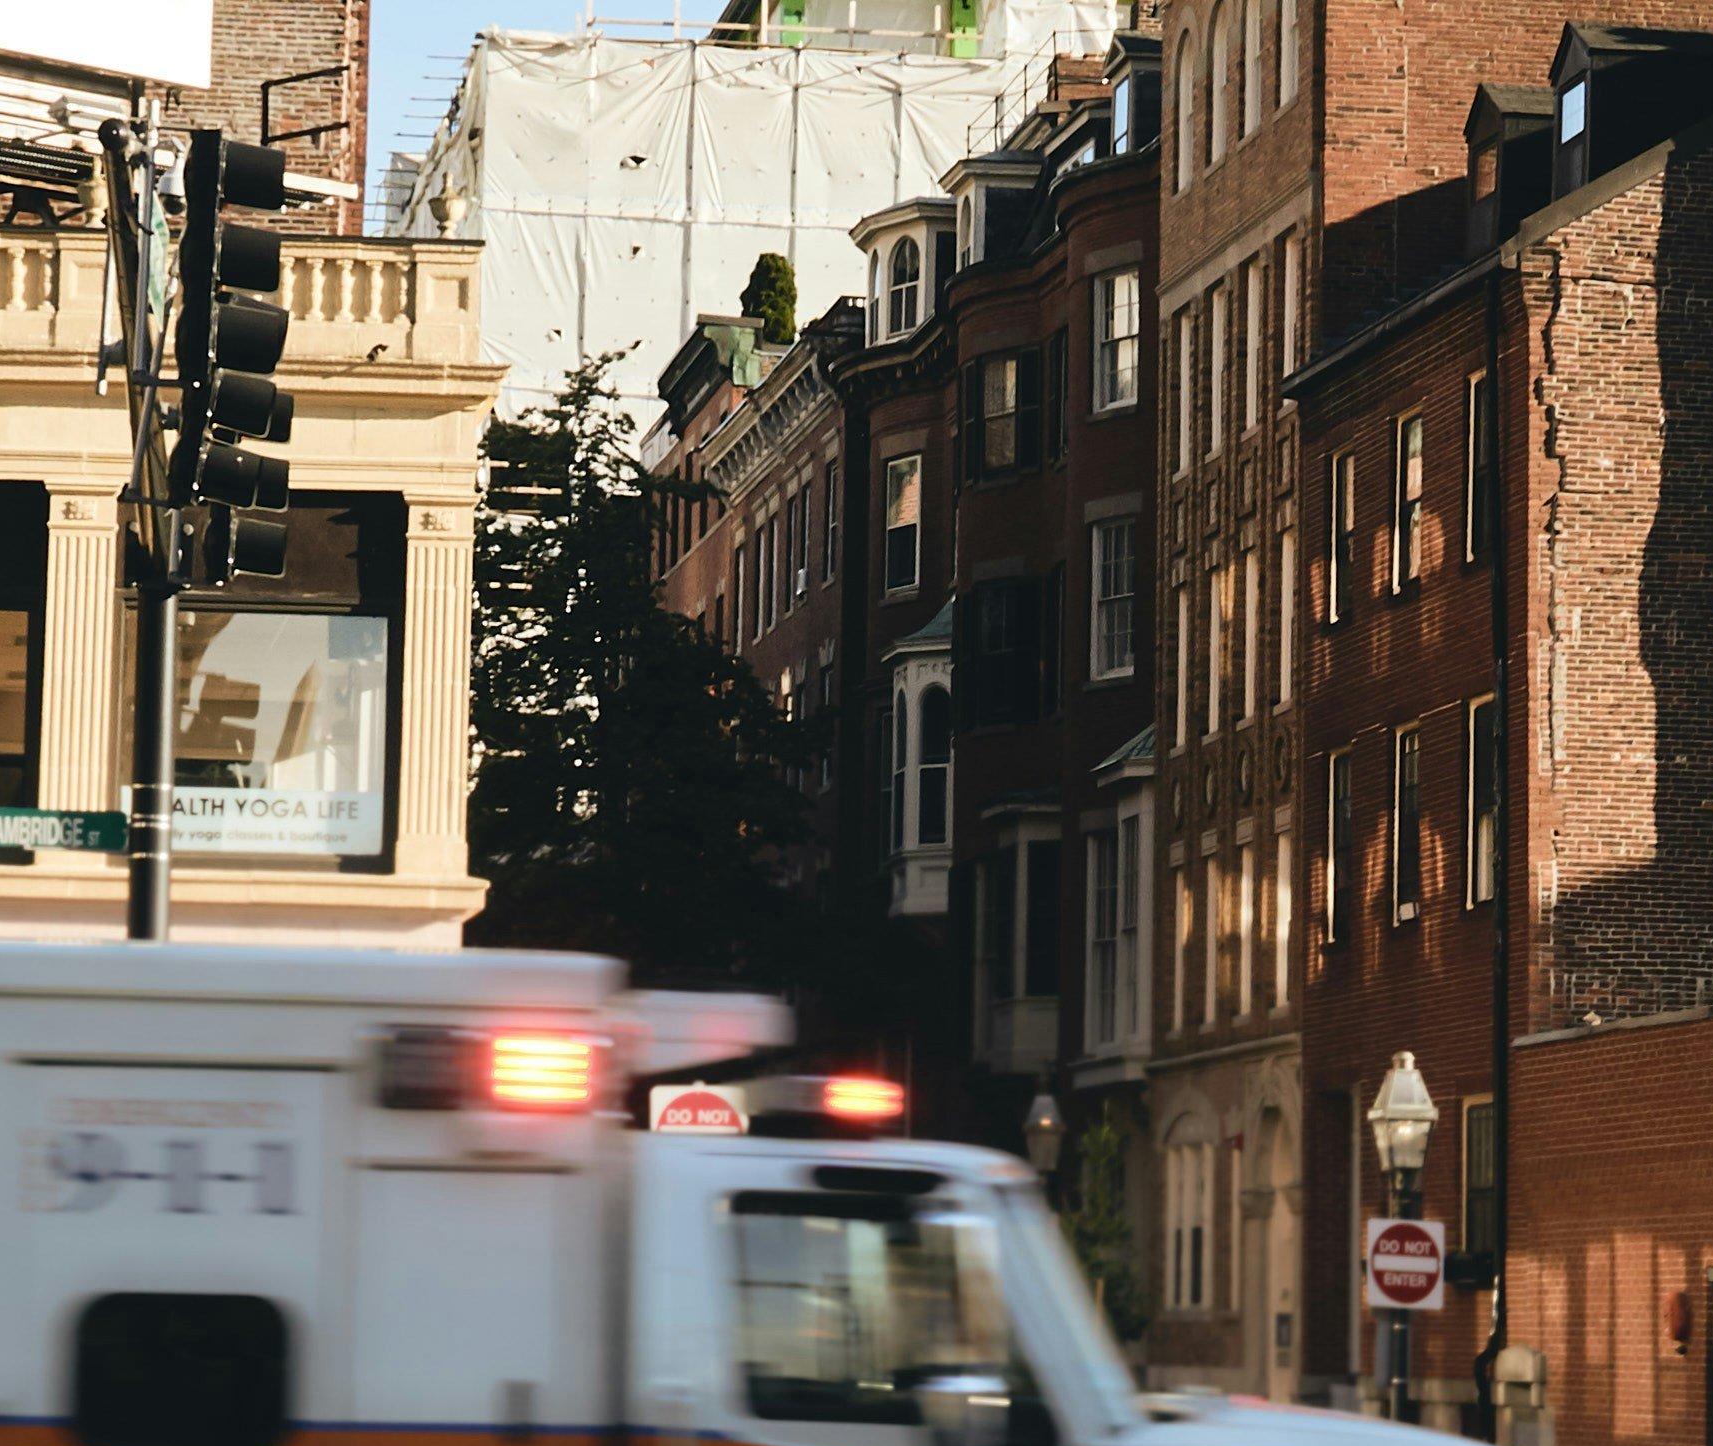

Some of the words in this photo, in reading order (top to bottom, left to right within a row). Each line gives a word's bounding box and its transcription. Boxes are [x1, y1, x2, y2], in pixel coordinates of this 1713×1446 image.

[172, 798, 225, 817] ALTH
[236, 798, 308, 819] YOGA
[318, 800, 359, 820] LIFE
[88, 831, 100, 847] ST
[189, 831, 222, 842] yoga
[227, 830, 273, 841] classes
[290, 830, 348, 843] boutique
[667, 1109, 693, 1124] DO
[697, 1109, 731, 1124] NOT
[1379, 1239, 1400, 1253] DO
[1404, 1240, 1432, 1255] NOT
[1383, 1272, 1427, 1287] ENTER
